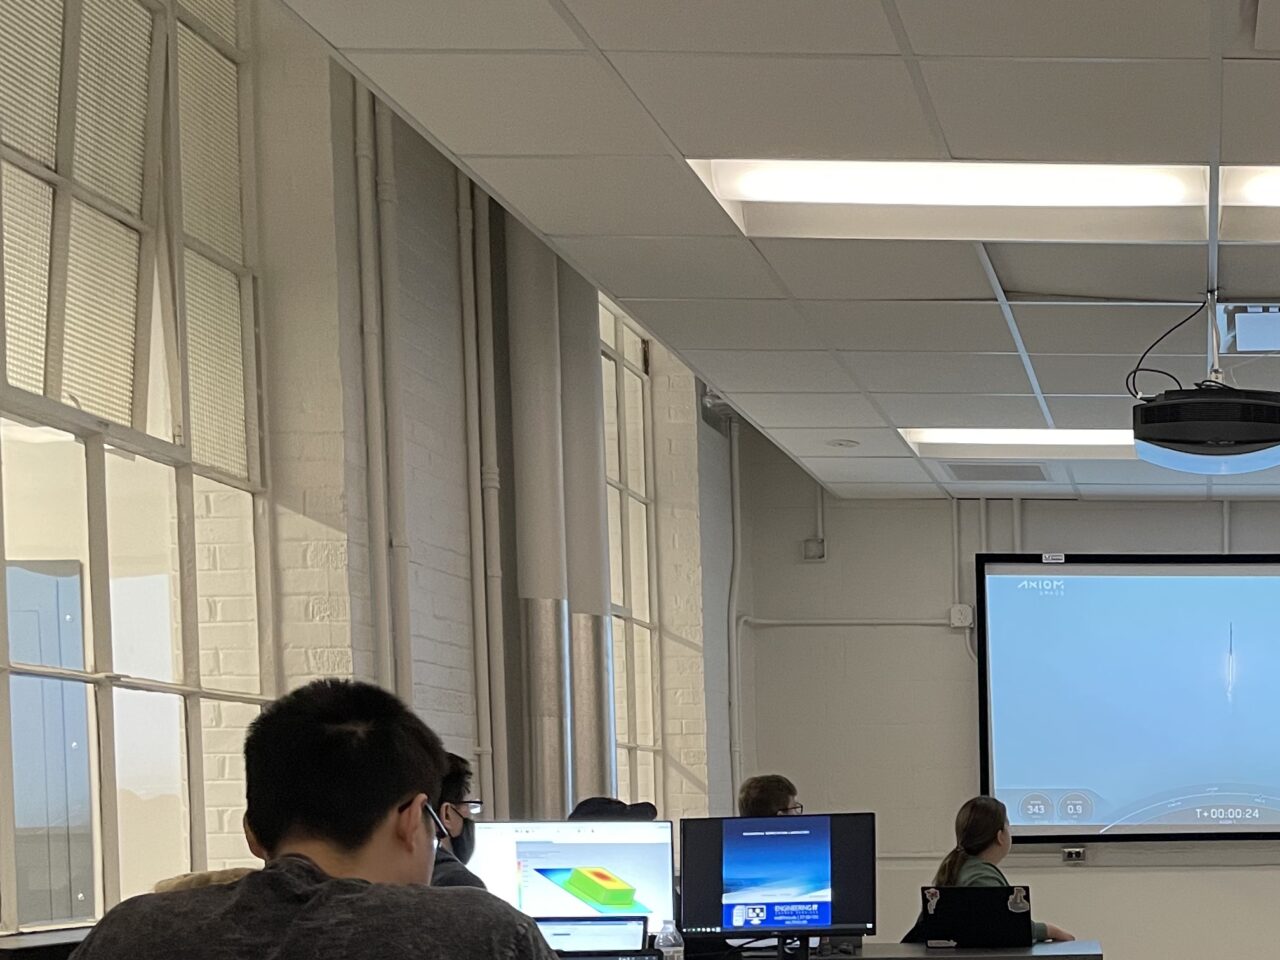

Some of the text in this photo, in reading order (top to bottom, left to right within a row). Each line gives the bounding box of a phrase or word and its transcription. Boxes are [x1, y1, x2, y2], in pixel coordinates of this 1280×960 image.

[1017, 580, 1065, 590] AXIOM
[1027, 805, 1045, 814] 343
[1067, 805, 1082, 814] 0.9
[1195, 808, 1260, 819] T+00:00:24
